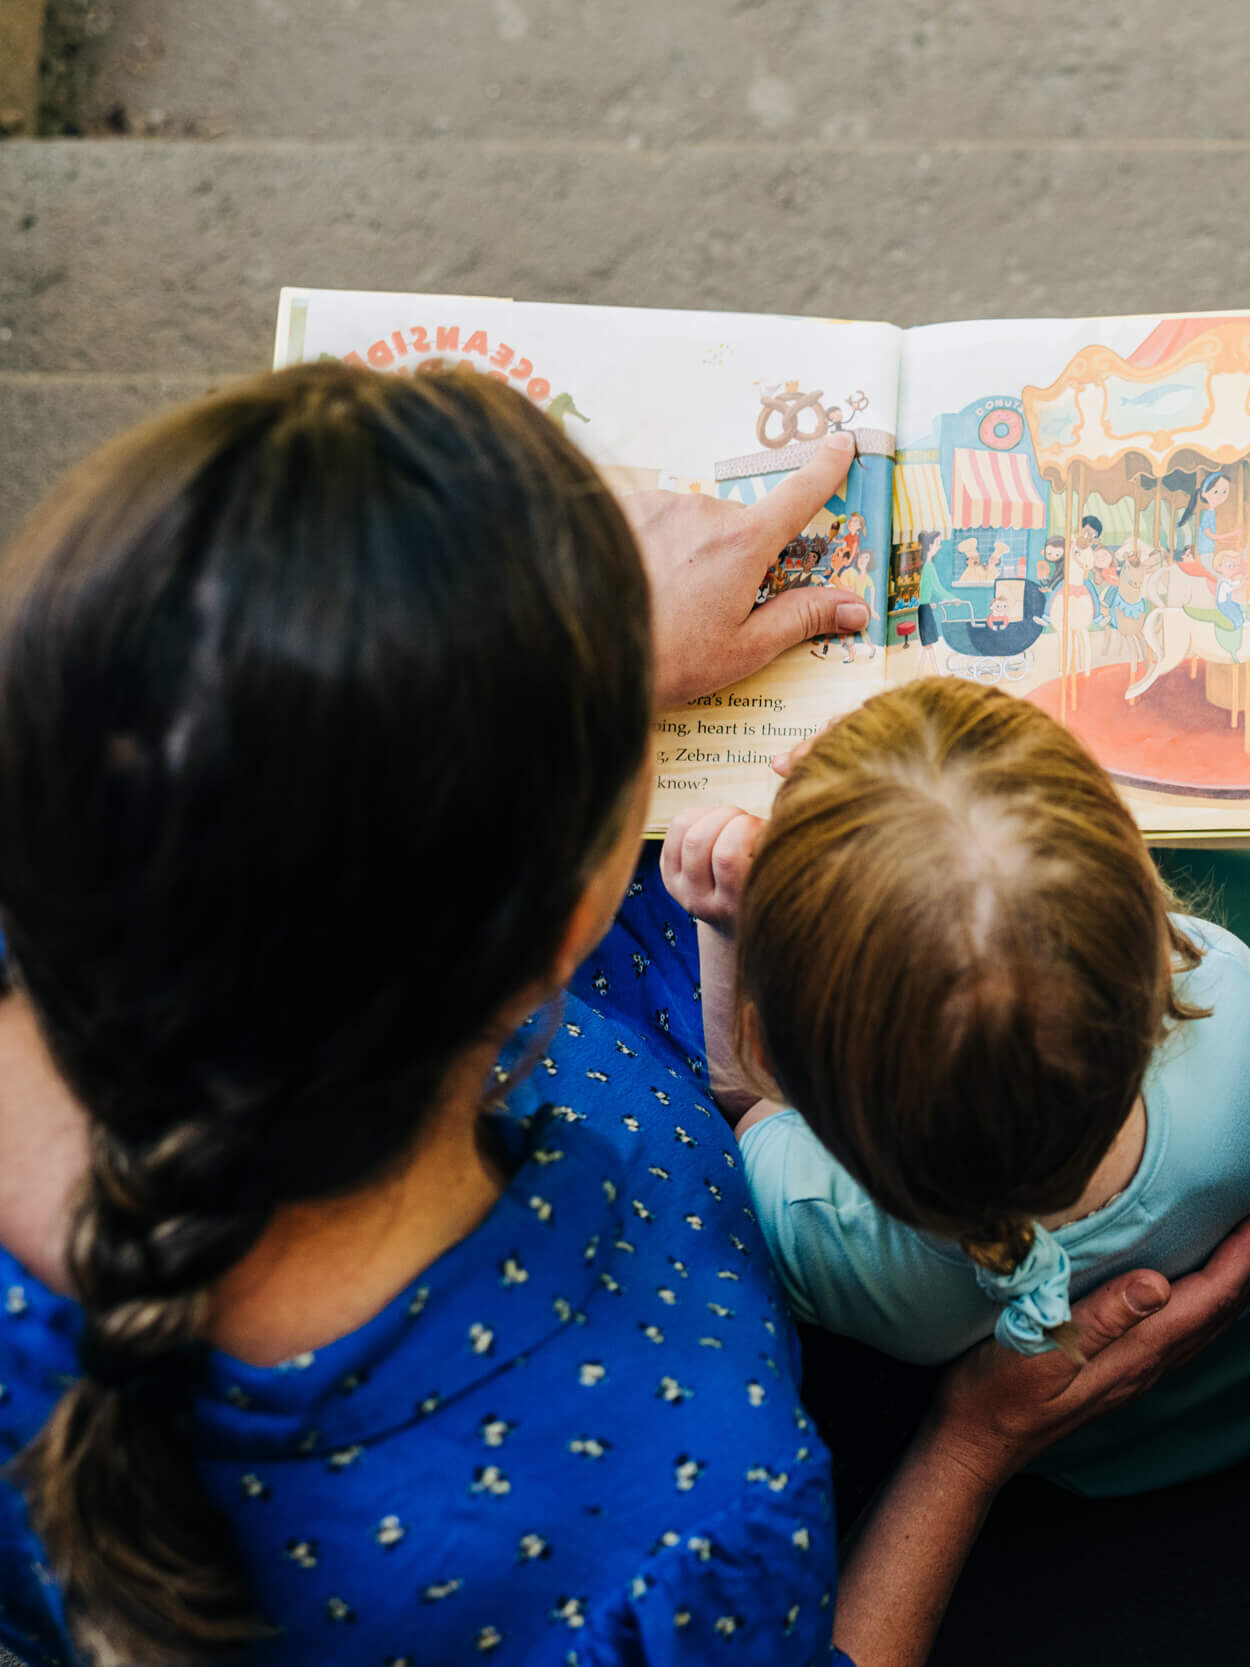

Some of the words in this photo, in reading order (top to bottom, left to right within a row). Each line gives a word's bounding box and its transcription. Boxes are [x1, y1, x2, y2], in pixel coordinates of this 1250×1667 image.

[687, 692, 722, 706] ra's
[728, 692, 786, 712] fearing.
[697, 719, 737, 735] heart
[743, 722, 756, 735] is
[675, 747, 720, 762] Zebra
[657, 775, 709, 791] know?
